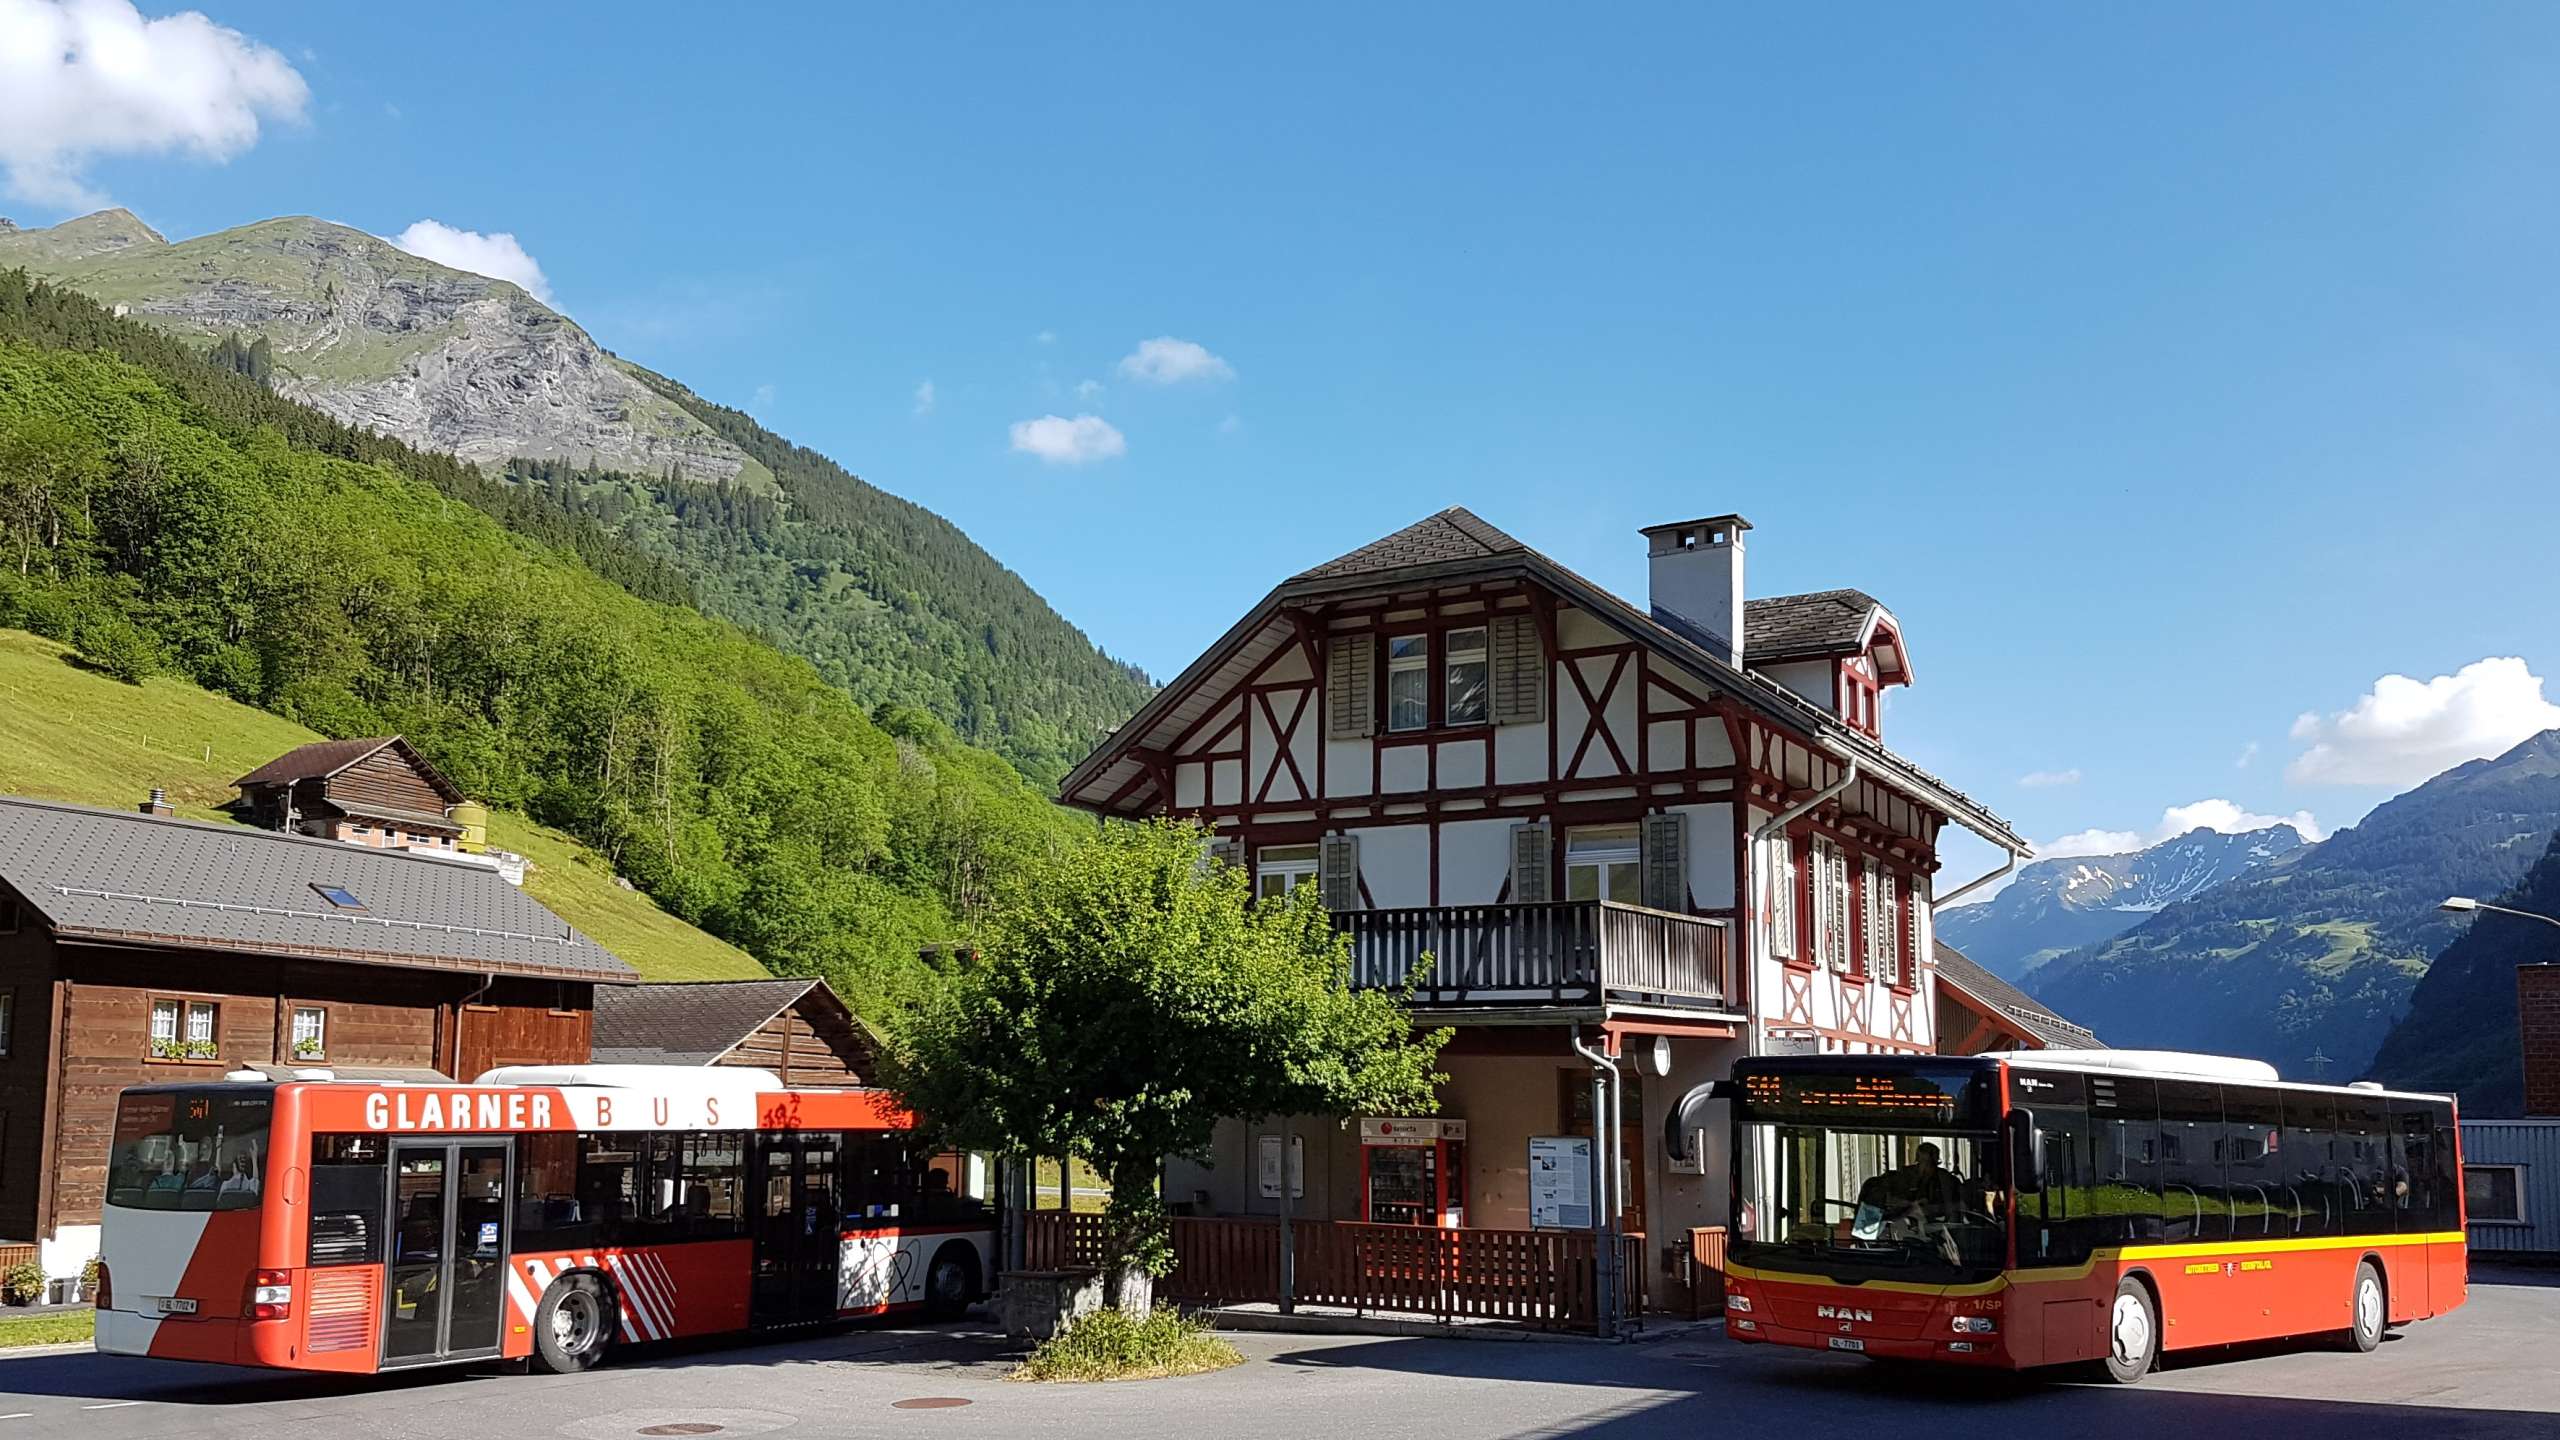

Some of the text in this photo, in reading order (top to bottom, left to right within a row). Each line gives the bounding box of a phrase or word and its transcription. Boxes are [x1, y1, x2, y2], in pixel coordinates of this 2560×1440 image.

[366, 1093, 550, 1129] GLARNER
[1817, 1305, 1873, 1322] MAN
[1973, 1300, 2002, 1310] 1/SP
